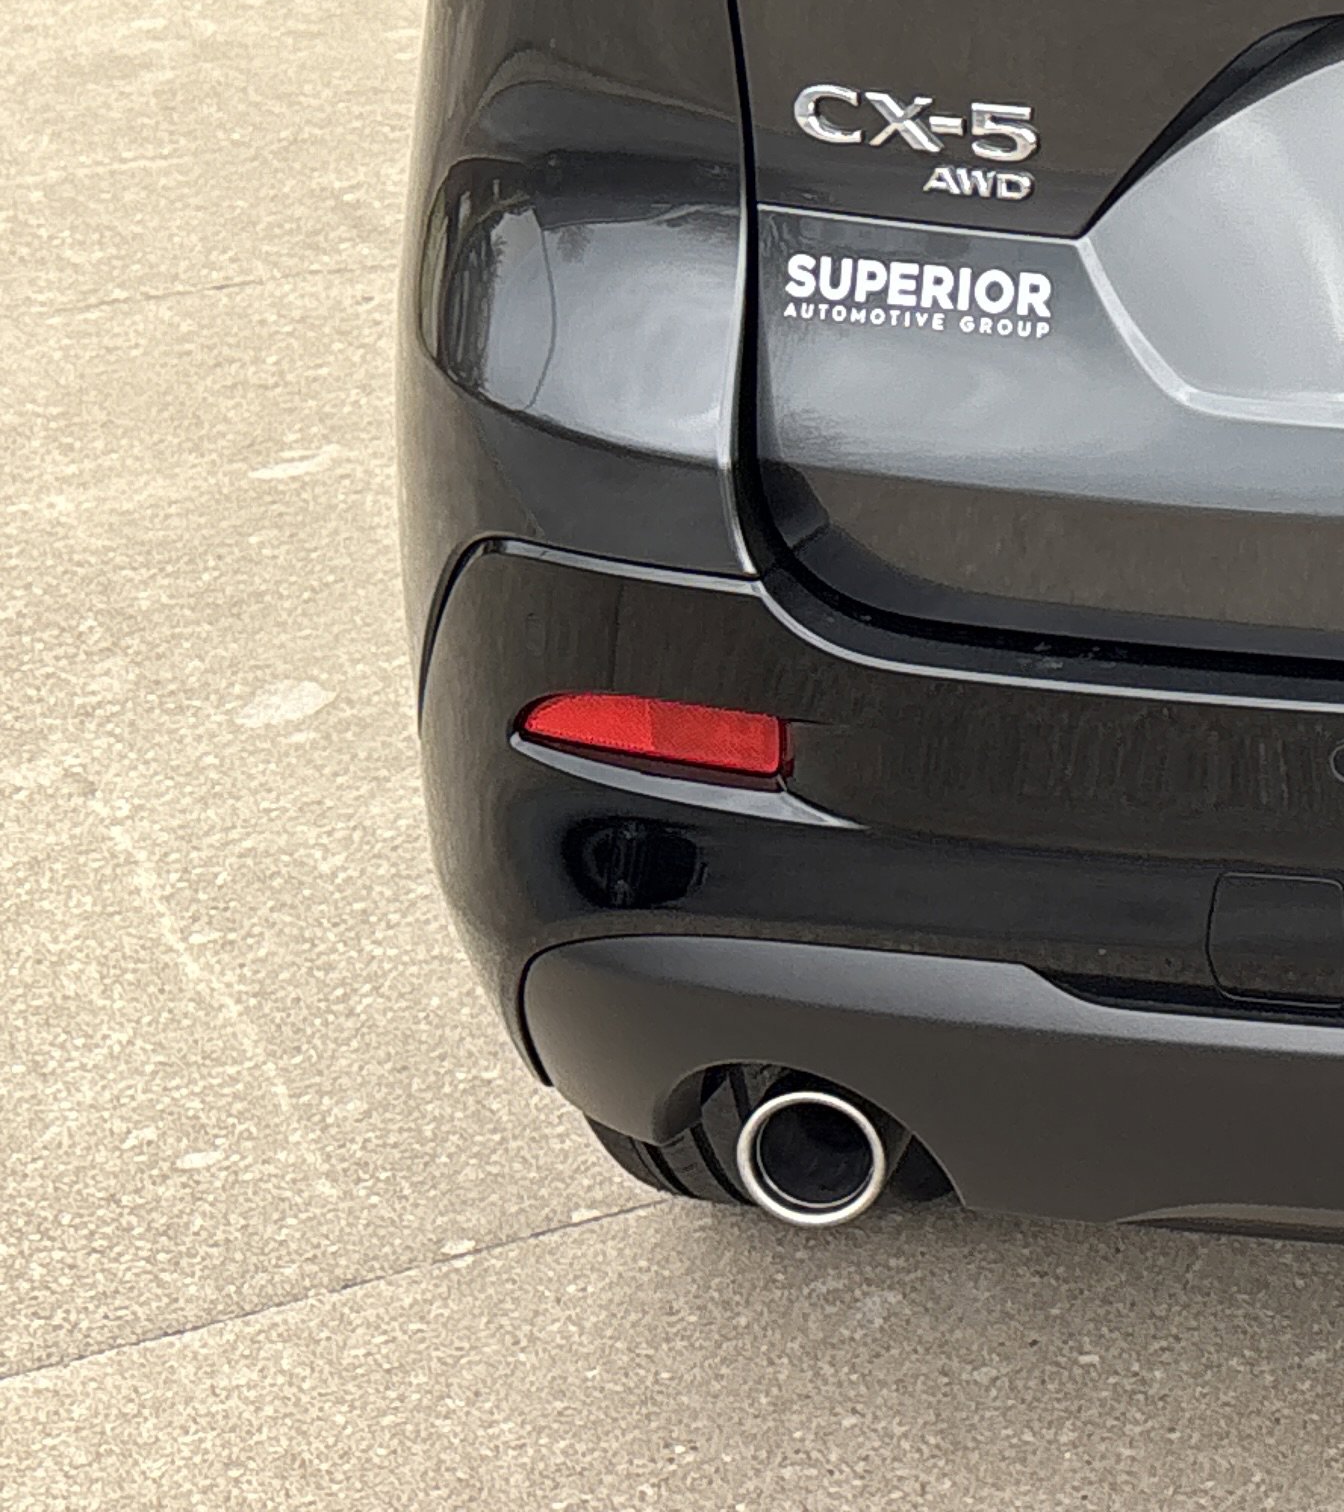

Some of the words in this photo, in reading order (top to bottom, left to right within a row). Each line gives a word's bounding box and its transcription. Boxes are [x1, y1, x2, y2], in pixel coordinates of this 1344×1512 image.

[793, 84, 1039, 162] CX-5
[922, 166, 1034, 201] AWD
[784, 253, 1052, 318] SUPERIOR
[783, 301, 945, 332] AUTOMOTIVE
[959, 314, 1051, 339] GROUP
